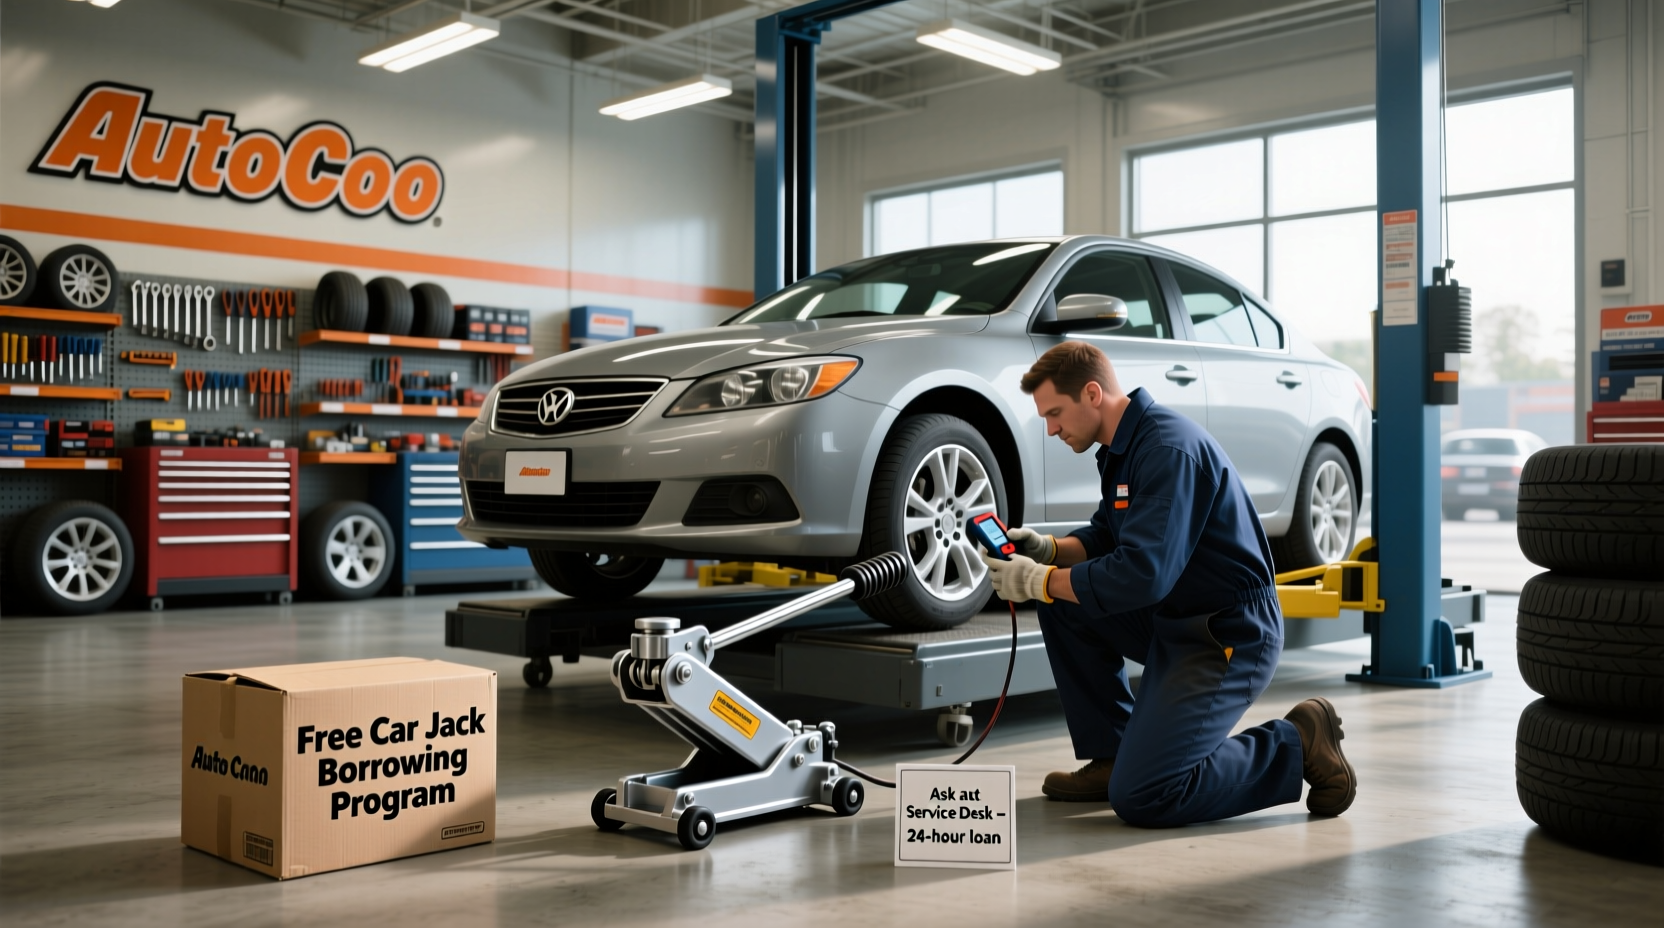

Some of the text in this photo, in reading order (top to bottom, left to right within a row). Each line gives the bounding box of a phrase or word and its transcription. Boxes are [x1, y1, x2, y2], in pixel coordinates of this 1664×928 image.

[27, 81, 444, 225] AutoCoo
[297, 706, 487, 755] Free Car Jack
[318, 744, 468, 787] Borrowing
[331, 782, 456, 821] Program
[906, 805, 957, 819] Service
[959, 805, 993, 820] Desk
[930, 786, 956, 801] Ask
[907, 828, 1002, 845] 24-hour loan
